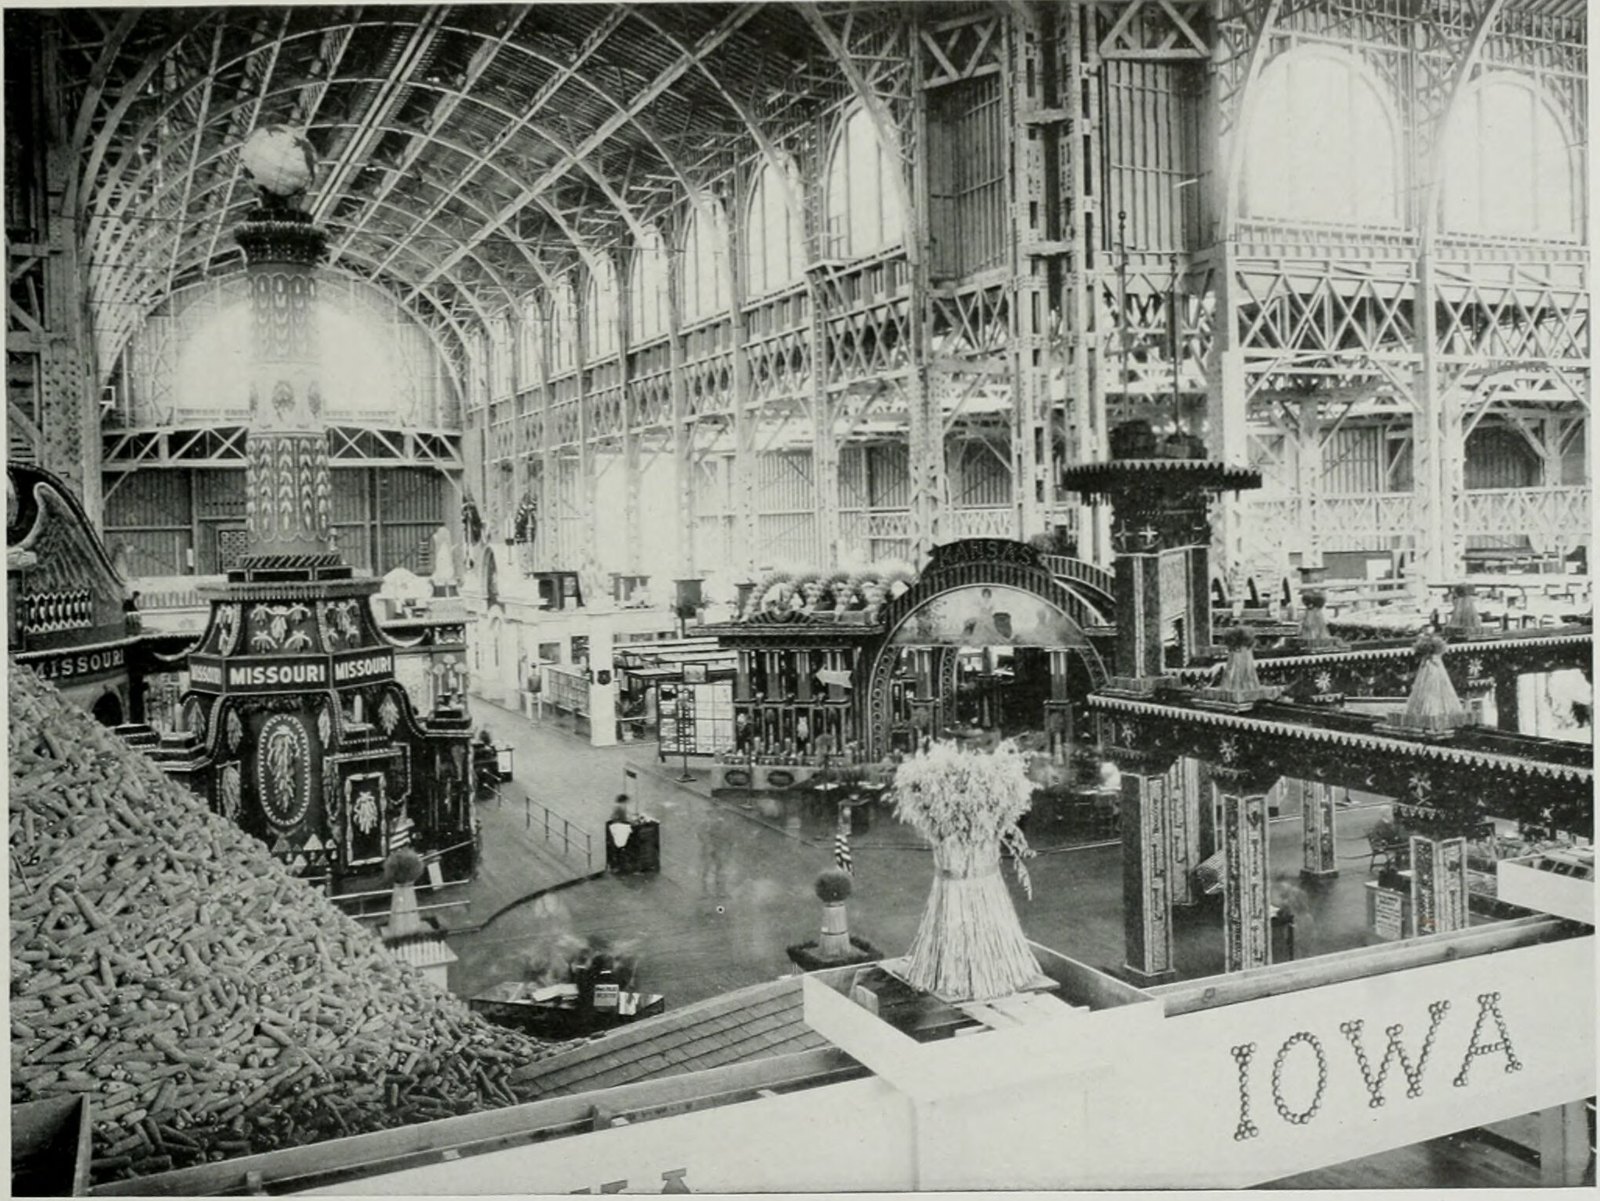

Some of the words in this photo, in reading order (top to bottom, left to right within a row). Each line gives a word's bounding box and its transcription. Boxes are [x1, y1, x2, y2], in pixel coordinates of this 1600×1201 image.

[940, 540, 1033, 569] KANSAS
[229, 664, 326, 686] MISSOURI
[334, 656, 392, 681] MISSOURI
[1231, 992, 1522, 1141] IOWA
